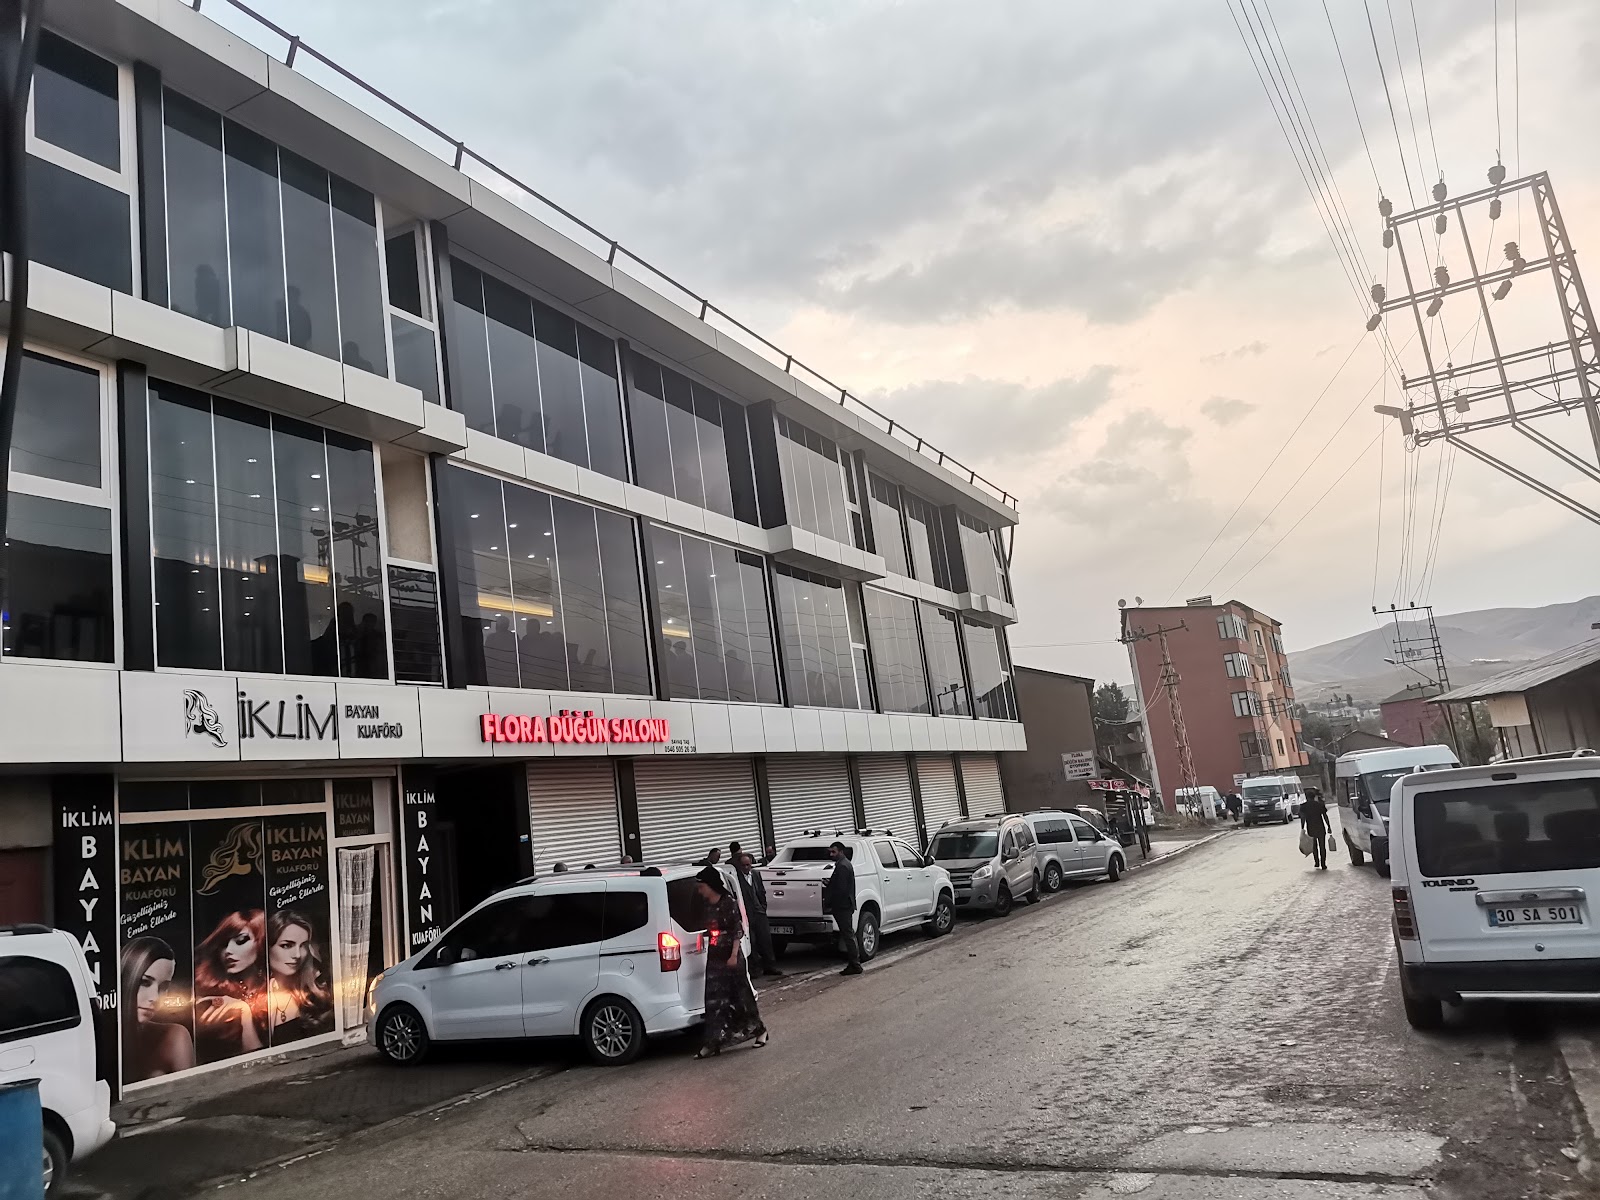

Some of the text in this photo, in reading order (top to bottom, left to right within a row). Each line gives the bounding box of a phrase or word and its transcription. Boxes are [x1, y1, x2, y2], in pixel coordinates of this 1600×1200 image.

[239, 691, 338, 741] İKLİM
[345, 705, 380, 719] BAYAN
[357, 723, 404, 739] KUAFÖRÜ
[480, 709, 671, 743] FLORA DÜĞÜN SALONU
[406, 789, 436, 805] İKLİM
[62, 805, 112, 828] İKLİM
[339, 813, 370, 825] BAYAN
[267, 825, 325, 845] İKLİM
[124, 833, 184, 861] KLİM
[271, 845, 323, 862] BAYAN
[120, 864, 181, 885] BAYAN
[1421, 878, 1475, 888] TOURNEO
[276, 883, 325, 909] Emin Ellerde
[127, 910, 177, 938] Emin Ellerde
[1497, 906, 1576, 923] 30 SA 501
